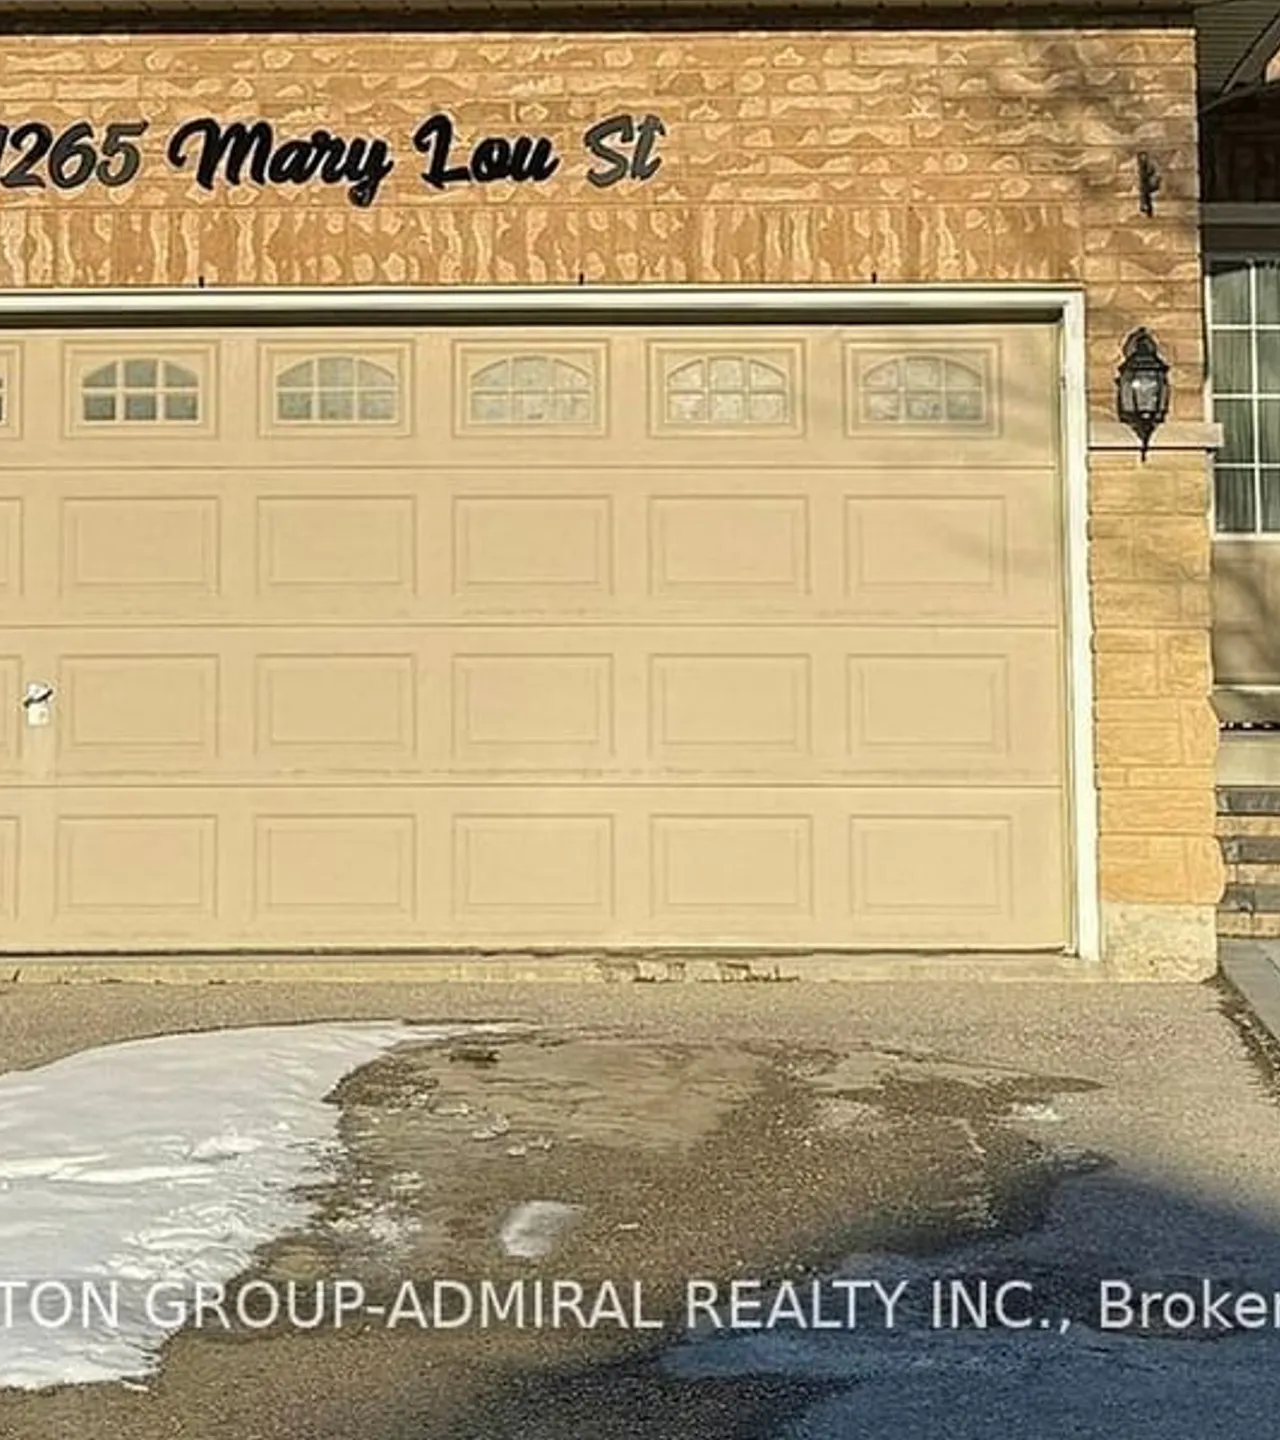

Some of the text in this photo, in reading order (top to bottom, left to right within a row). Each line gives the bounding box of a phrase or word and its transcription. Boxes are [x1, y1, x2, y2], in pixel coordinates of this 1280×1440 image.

[167, 117, 394, 208] Mary
[412, 113, 560, 190] Lou
[583, 114, 666, 188] St
